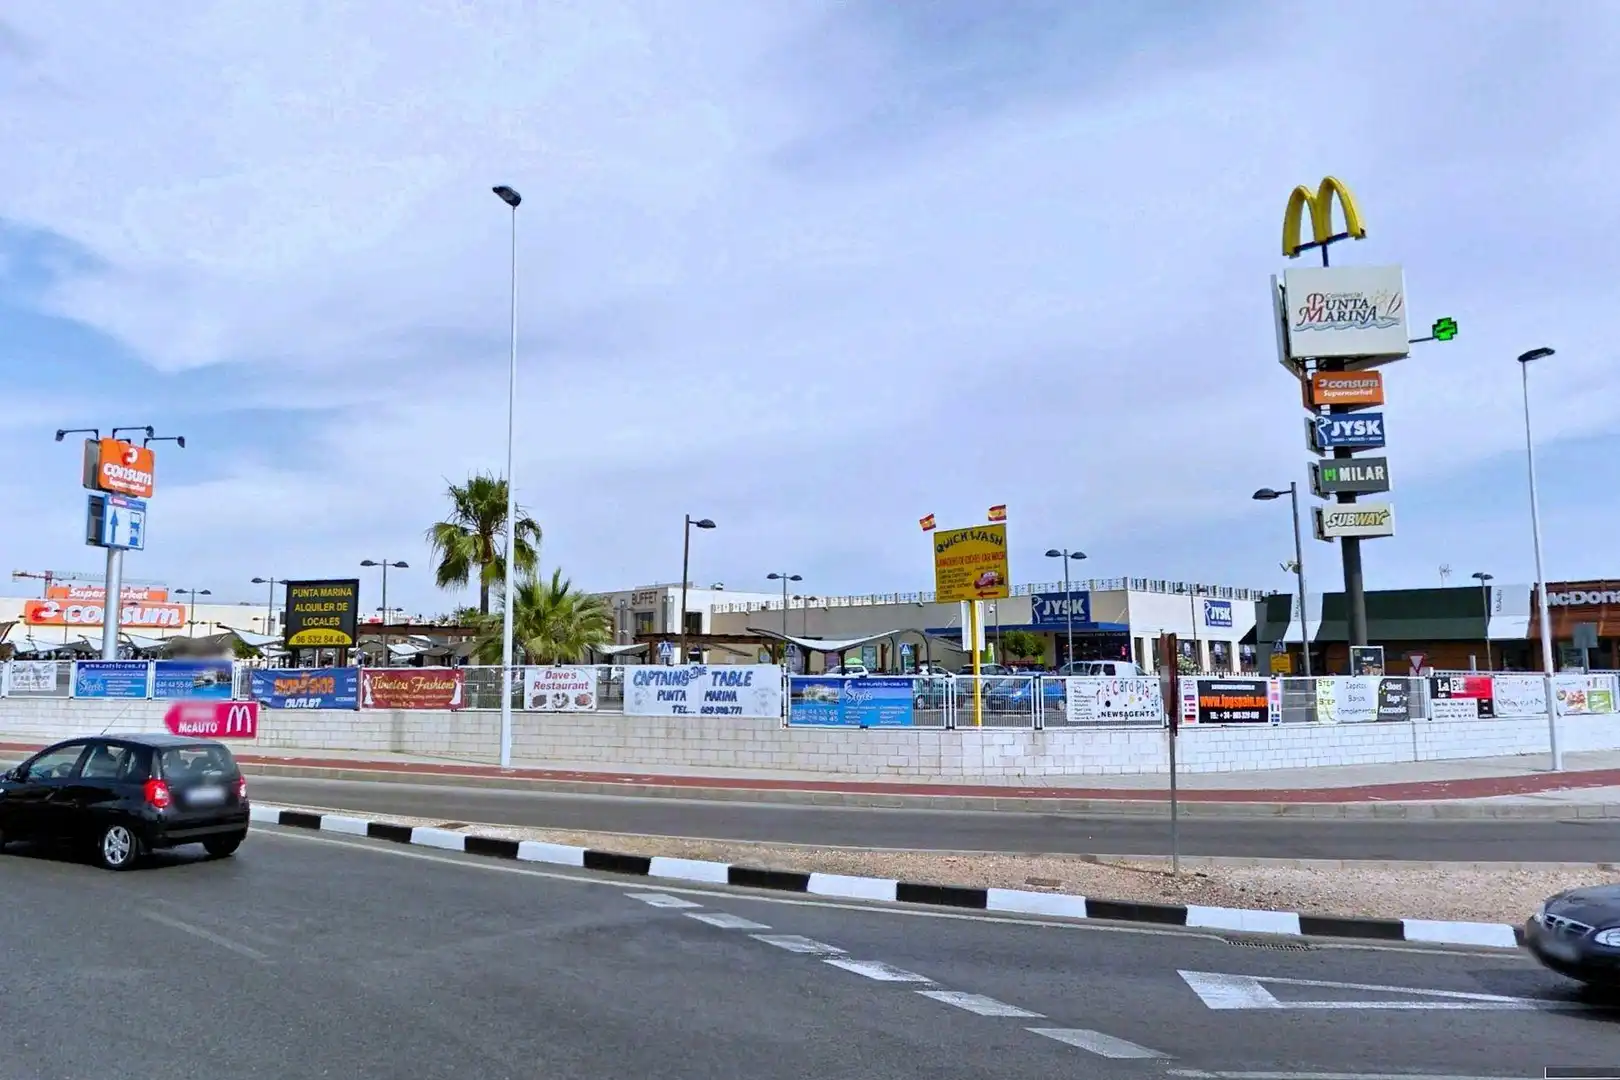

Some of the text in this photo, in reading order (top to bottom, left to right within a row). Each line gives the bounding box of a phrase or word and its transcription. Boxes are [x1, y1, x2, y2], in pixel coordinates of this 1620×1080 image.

[1306, 293, 1369, 311] PUNTA
[1296, 305, 1376, 326] MARINA
[1330, 420, 1382, 437] JYSK
[103, 463, 152, 486] consum
[1339, 466, 1385, 482] MILAR
[1327, 511, 1388, 528] SUBWAY
[292, 587, 353, 598] PUNTA MARINA
[631, 590, 657, 605] BUFFET
[295, 602, 349, 612] ALQUILER DE
[1043, 599, 1085, 616] JYSK
[1211, 607, 1231, 621] JYSK
[303, 617, 340, 626] LOCALES
[533, 681, 589, 690] Restaurant
[711, 671, 753, 687] TABLE
[657, 690, 738, 702] PUNTA MARINA
[1101, 710, 1155, 719] NEWSAGENTS
[178, 721, 218, 733] McAUTO
